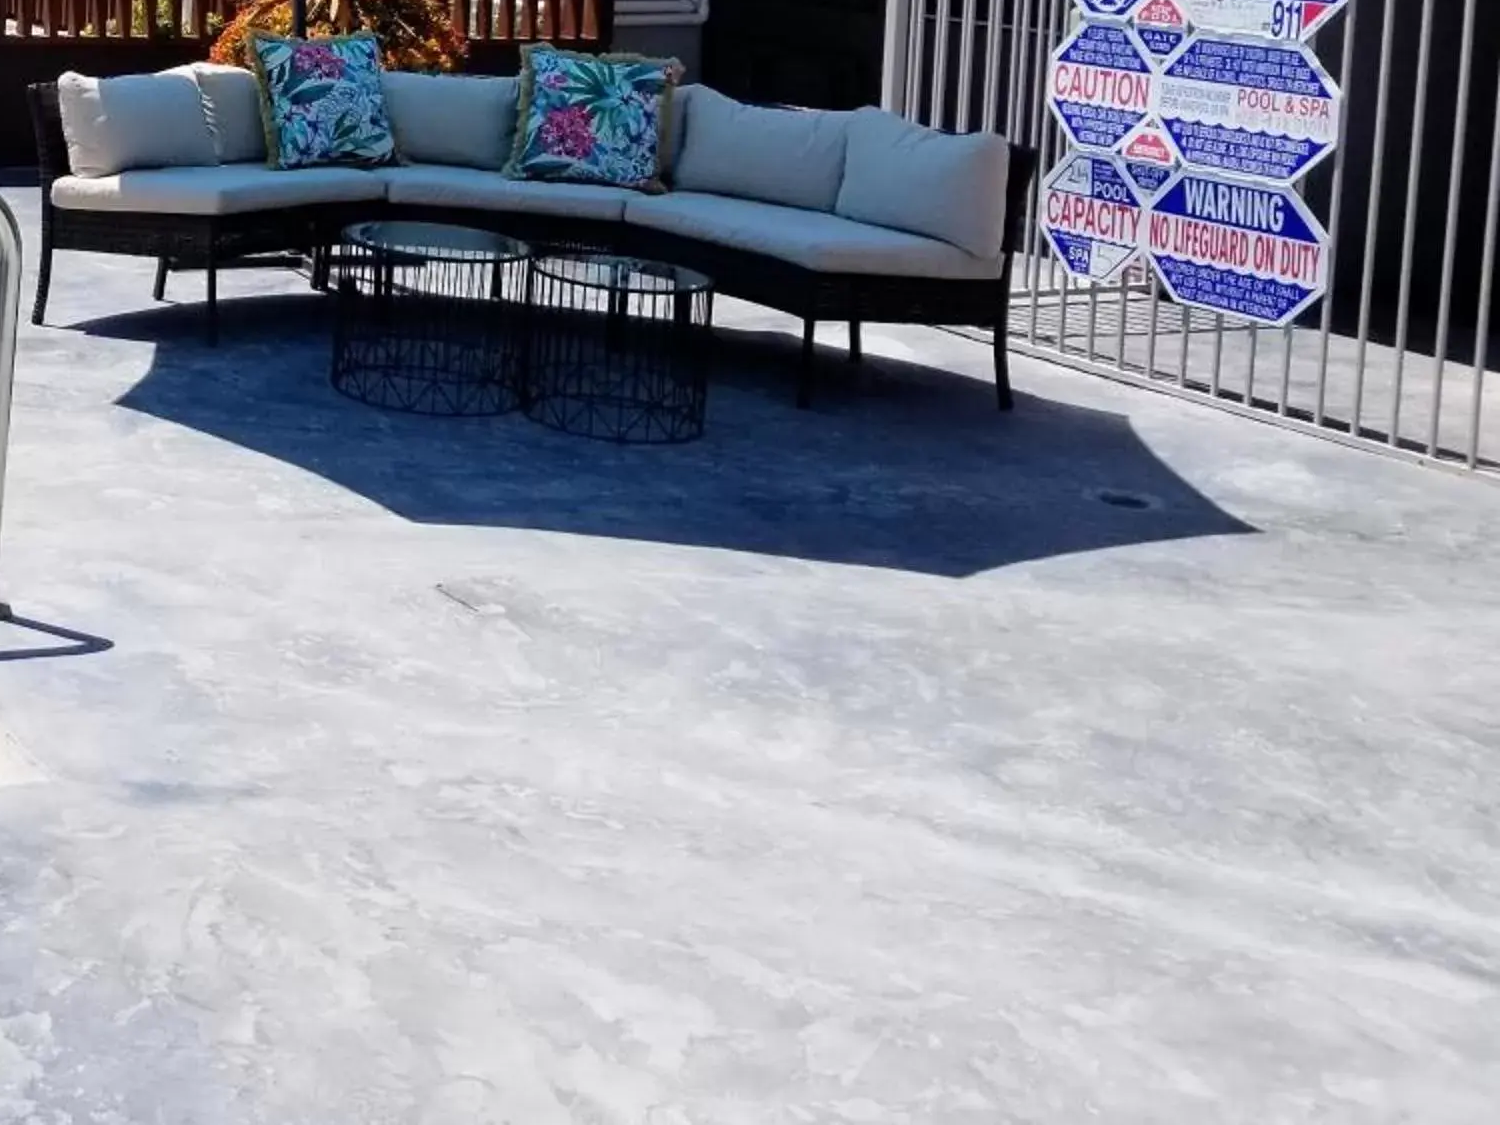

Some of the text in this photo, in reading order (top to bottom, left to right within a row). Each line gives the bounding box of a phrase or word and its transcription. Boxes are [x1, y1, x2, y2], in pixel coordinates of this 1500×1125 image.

[1143, 31, 1177, 44] GATE
[1271, 0, 1302, 41] 911
[1055, 63, 1150, 108] CAUTION
[1237, 88, 1280, 112] POOL
[1285, 97, 1294, 114] &
[1299, 98, 1330, 120] SPA
[1094, 181, 1131, 202] POOL
[1183, 178, 1285, 233] WARNING
[1047, 192, 1142, 243] CAPACITY
[1069, 246, 1089, 264] SPA
[1150, 212, 1321, 283] NO LIFEGUARD ON DUTY
